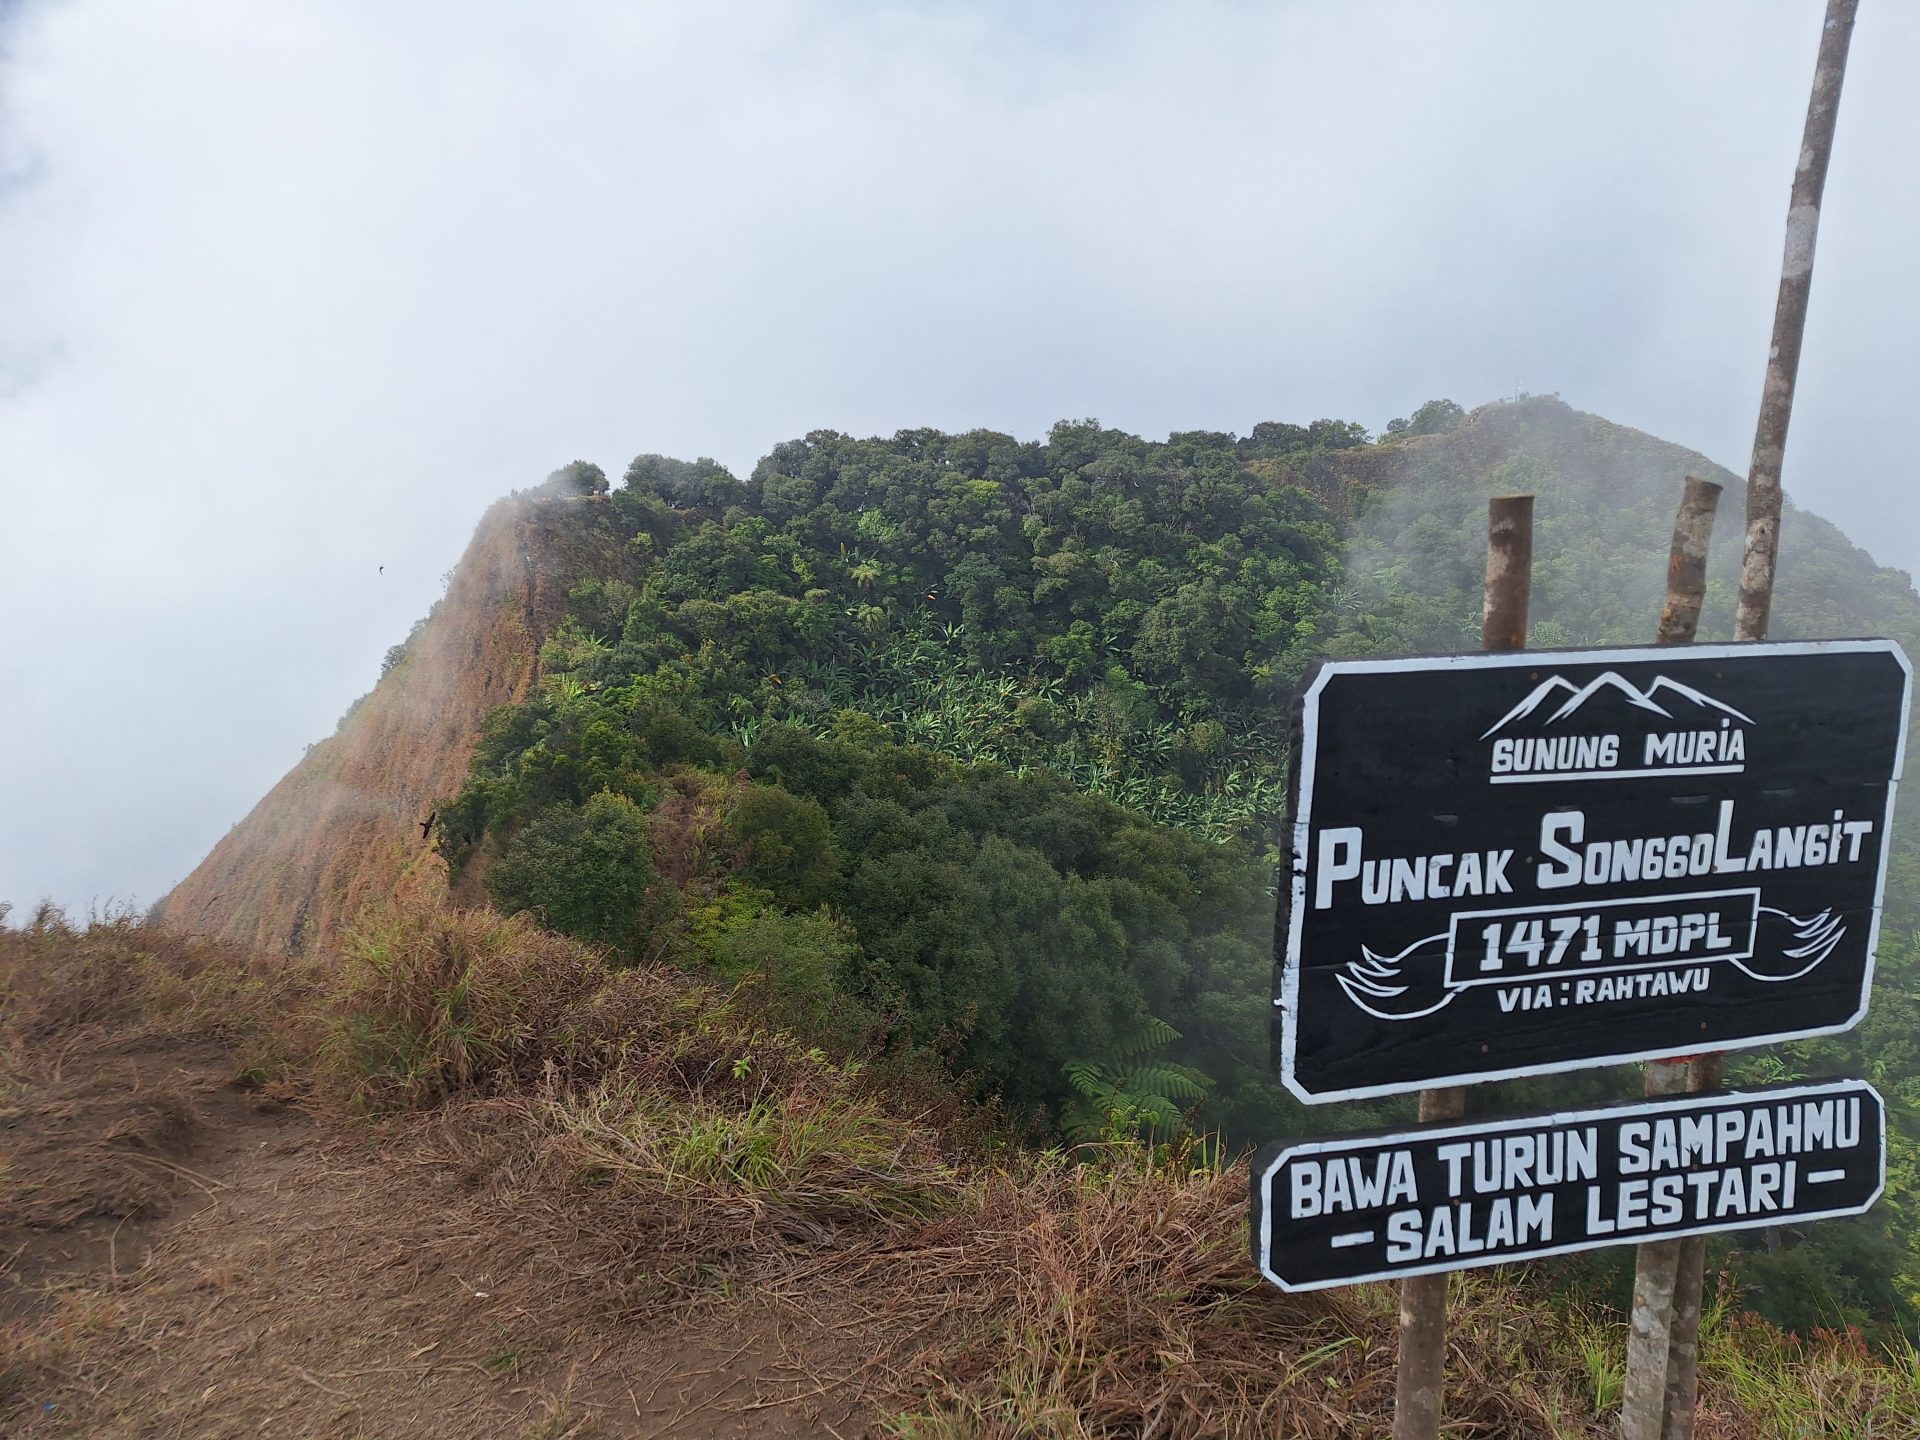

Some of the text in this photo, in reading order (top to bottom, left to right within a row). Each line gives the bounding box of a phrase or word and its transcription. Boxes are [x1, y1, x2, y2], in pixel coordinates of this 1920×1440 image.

[1491, 733, 1619, 774] GUNUNG
[1480, 911, 1732, 972] 1471 MDPL
[1575, 967, 1712, 1005] RAHTAWU
[1290, 1097, 1862, 1220] BAWA TURUN SAMPAHMU
[1386, 1193, 1554, 1264] SALAM
[1585, 1160, 1798, 1235] LESTARI
